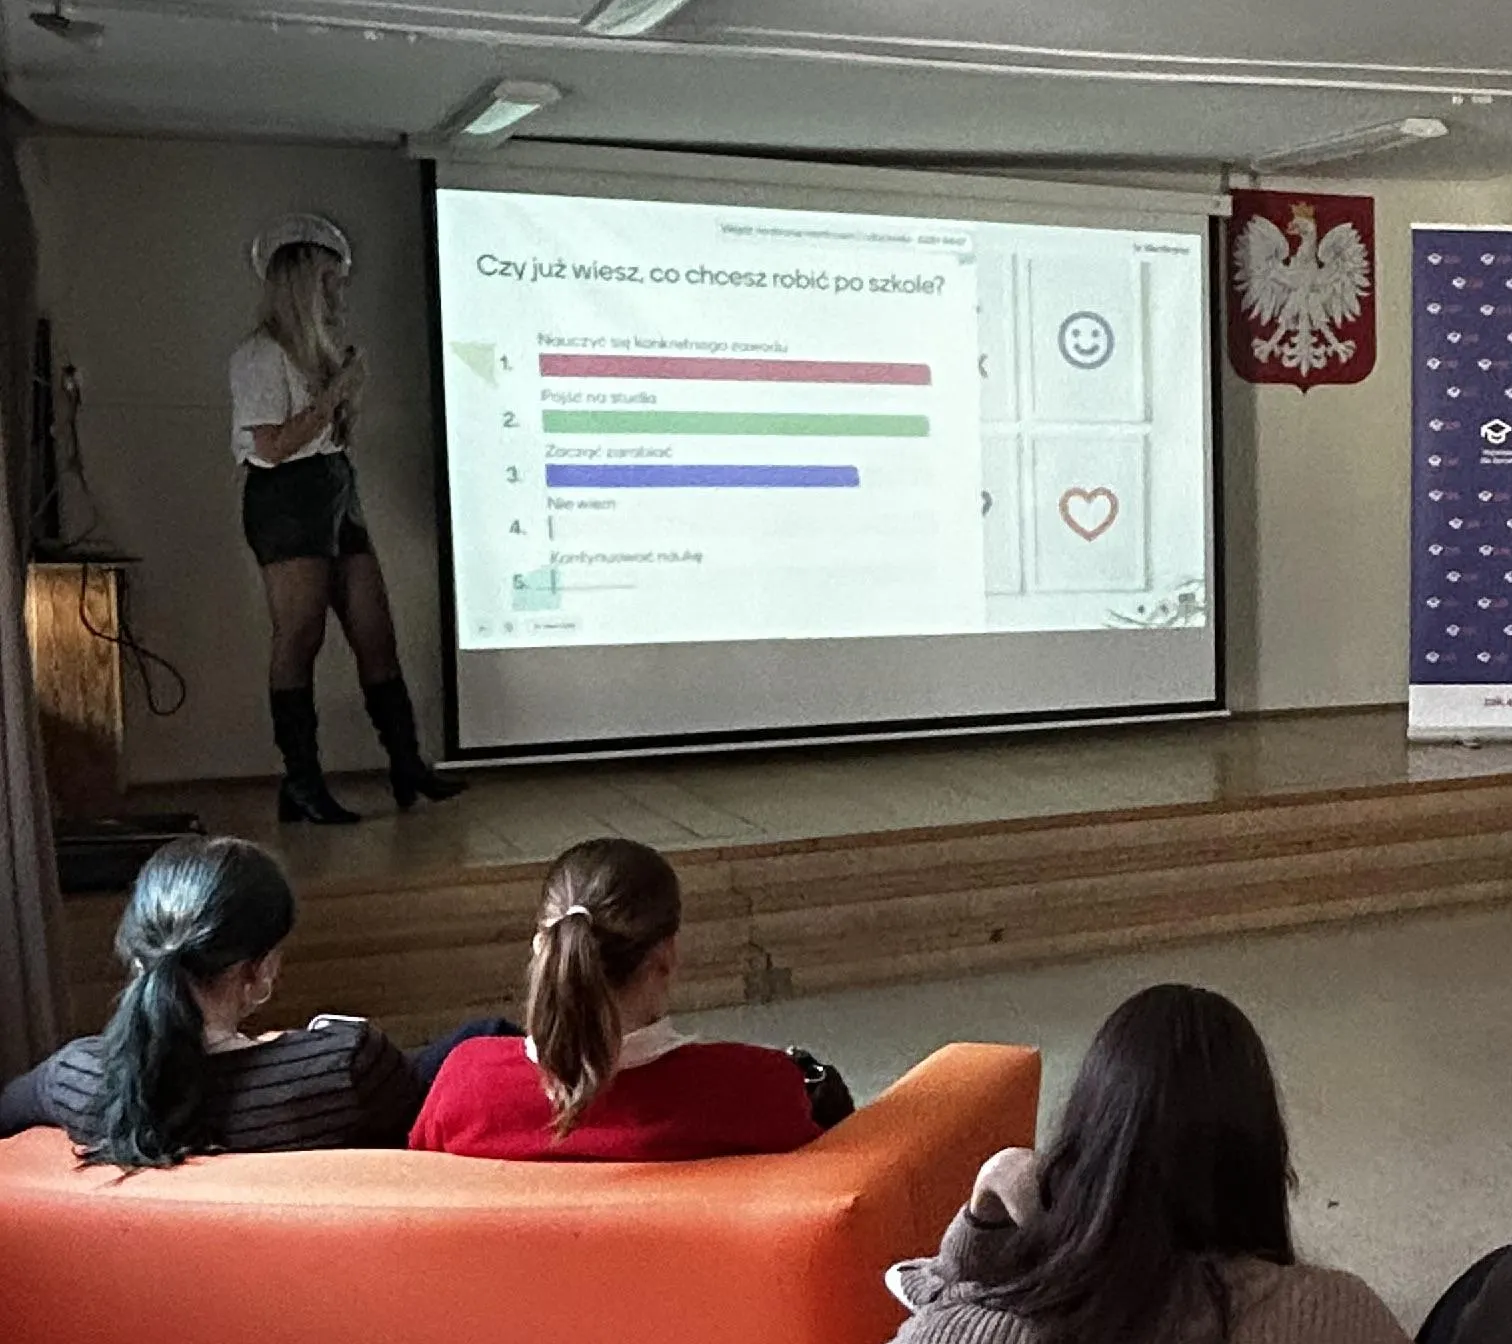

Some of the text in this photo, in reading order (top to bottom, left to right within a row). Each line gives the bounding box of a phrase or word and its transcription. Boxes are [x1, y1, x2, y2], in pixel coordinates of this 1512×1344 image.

[477, 254, 946, 295] Czy już wiesz, co chcesz robić po szkole?
